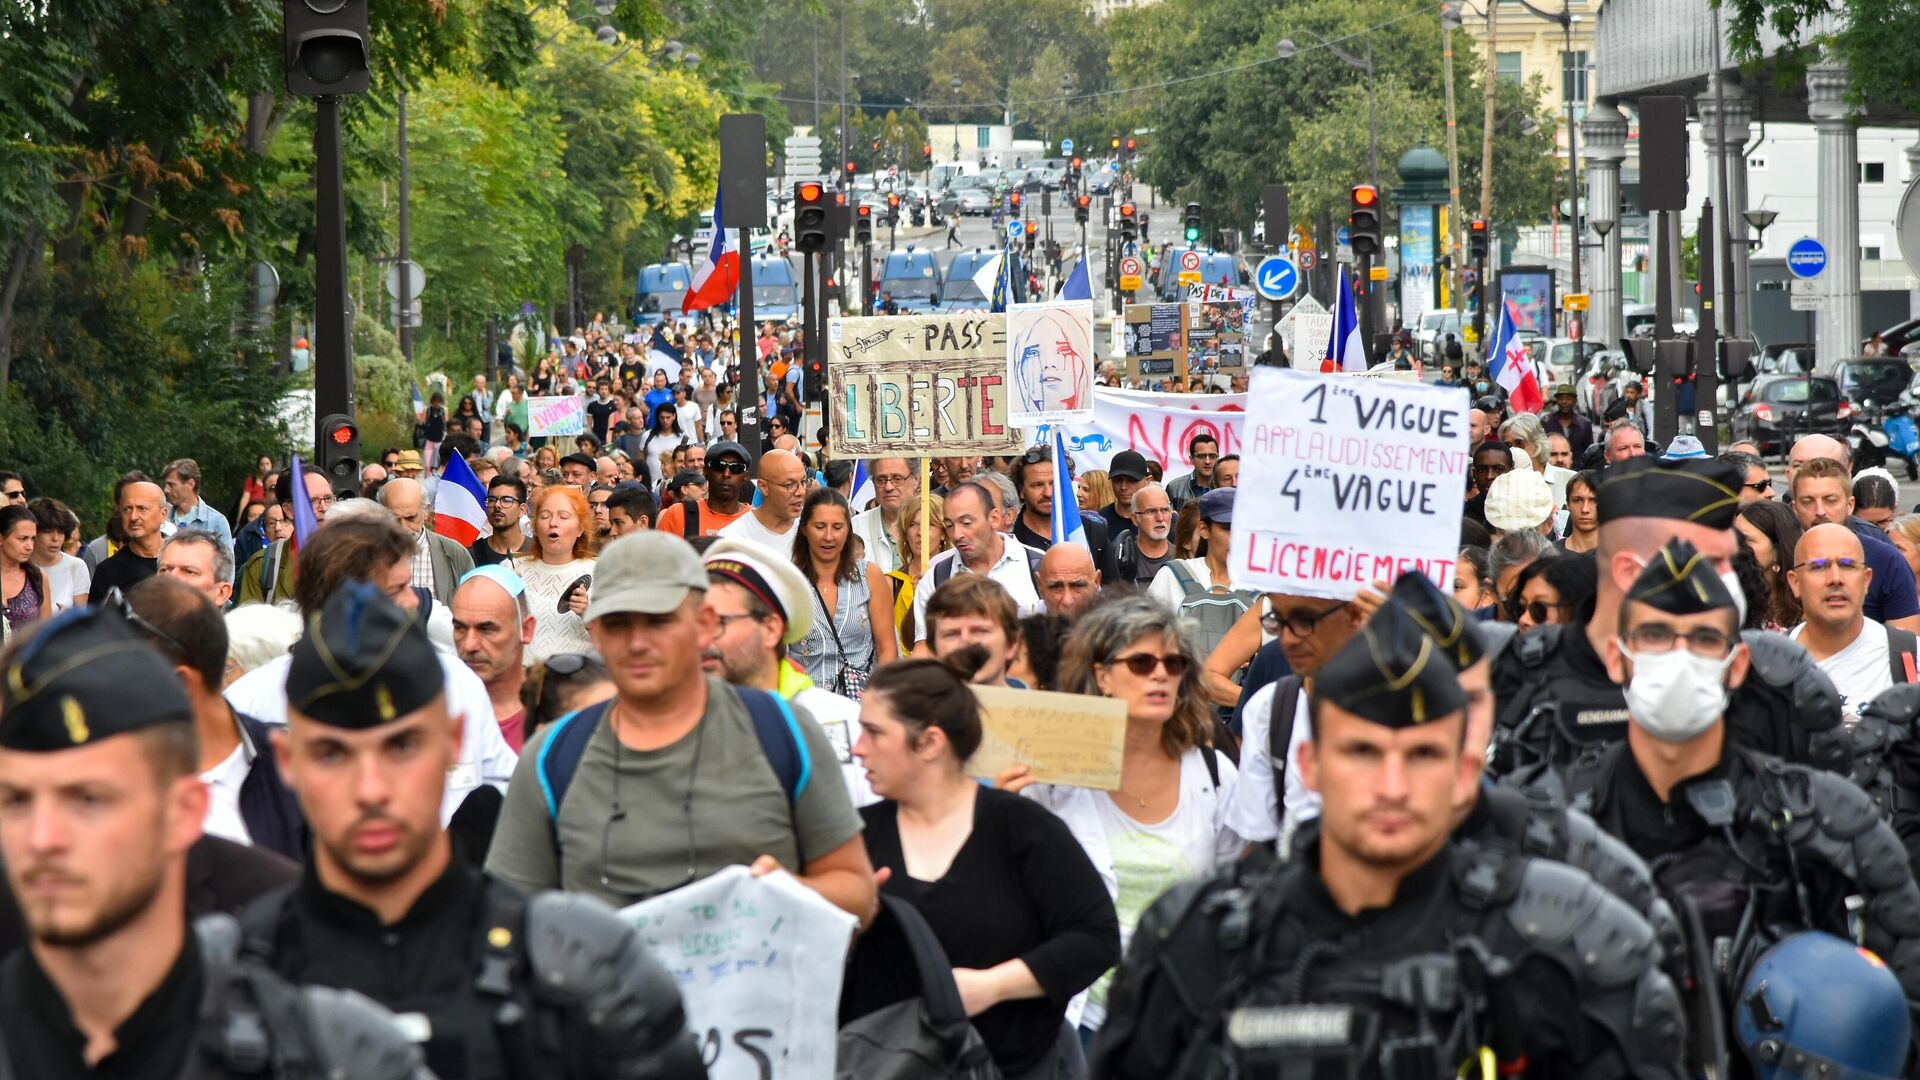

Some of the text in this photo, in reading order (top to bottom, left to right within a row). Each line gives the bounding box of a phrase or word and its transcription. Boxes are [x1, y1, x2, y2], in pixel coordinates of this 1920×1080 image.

[1187, 282, 1203, 298] PAS
[924, 320, 988, 351] PASS
[1304, 316, 1329, 327] TAUX
[1354, 394, 1459, 438] VAGUE
[1332, 473, 1437, 514] VAGUE
